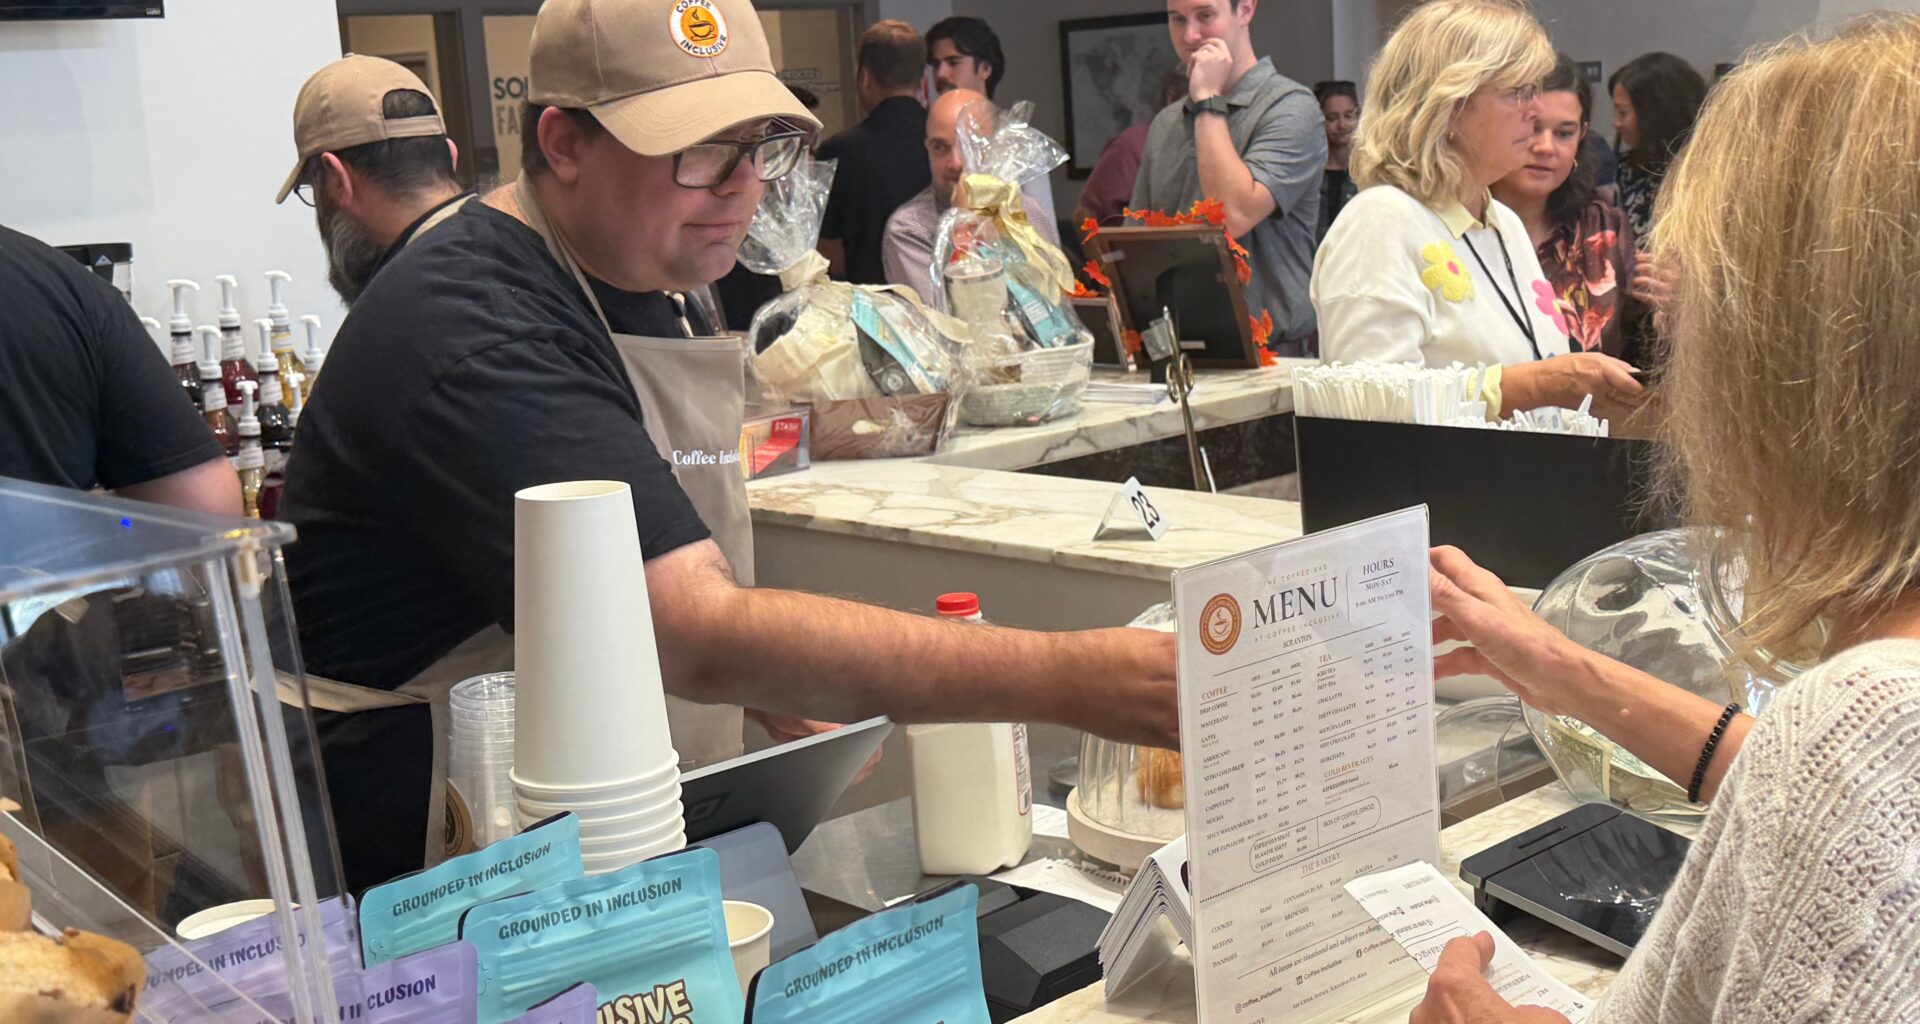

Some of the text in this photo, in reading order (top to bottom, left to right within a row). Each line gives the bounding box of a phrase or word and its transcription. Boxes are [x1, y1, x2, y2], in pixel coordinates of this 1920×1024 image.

[676, 0, 711, 13] COFFEE
[680, 34, 727, 55] INCLUSIVE
[774, 421, 799, 432] STASH
[672, 450, 716, 465] Coffee
[1131, 490, 1160, 529] 23
[1363, 558, 1394, 575] HOURS
[1253, 577, 1339, 629] MENU
[1268, 626, 1296, 639] COFFEE
[1302, 613, 1340, 629] INCLUSIVE
[1283, 633, 1312, 648] SCRANTON
[1320, 654, 1332, 662] TEA
[1202, 686, 1227, 700] COFFEE
[1325, 755, 1374, 778] COLD BEVERAGES
[1342, 810, 1358, 820] COFFEE
[1303, 853, 1340, 872] THE BAKERY
[393, 842, 551, 917] GROUNDED IN INCLUSION
[499, 877, 682, 940] GROUNDED IN INCLUSION
[785, 914, 944, 998] GROUNDED IN INCLUSION
[1270, 967, 1278, 977] All
[1279, 962, 1292, 972] items
[1304, 944, 1329, 961] rotational
[1330, 939, 1339, 950] and
[1341, 931, 1358, 947] subject
[1364, 942, 1379, 953] Coffee
[210, 954, 226, 973] IN
[1305, 968, 1321, 980] Coffee
